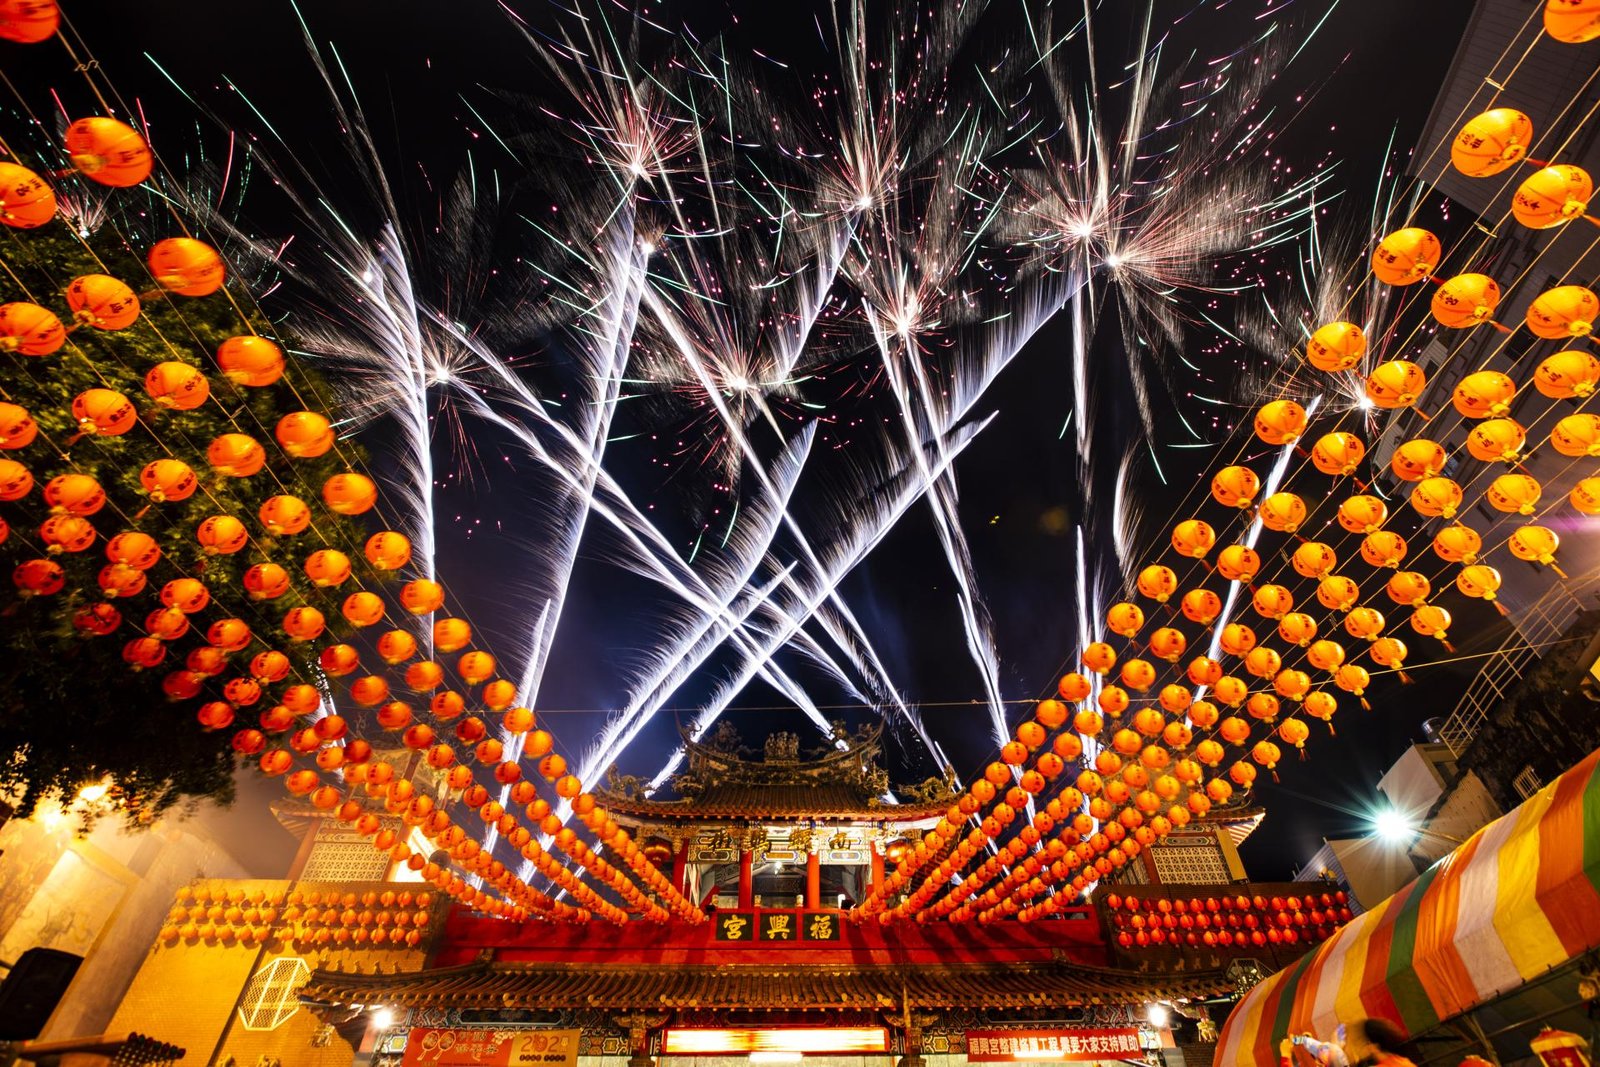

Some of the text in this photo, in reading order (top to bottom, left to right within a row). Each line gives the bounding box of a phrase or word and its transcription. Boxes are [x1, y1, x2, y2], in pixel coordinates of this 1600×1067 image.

[723, 914, 833, 939] 福興宮
[519, 1034, 569, 1052] 202
